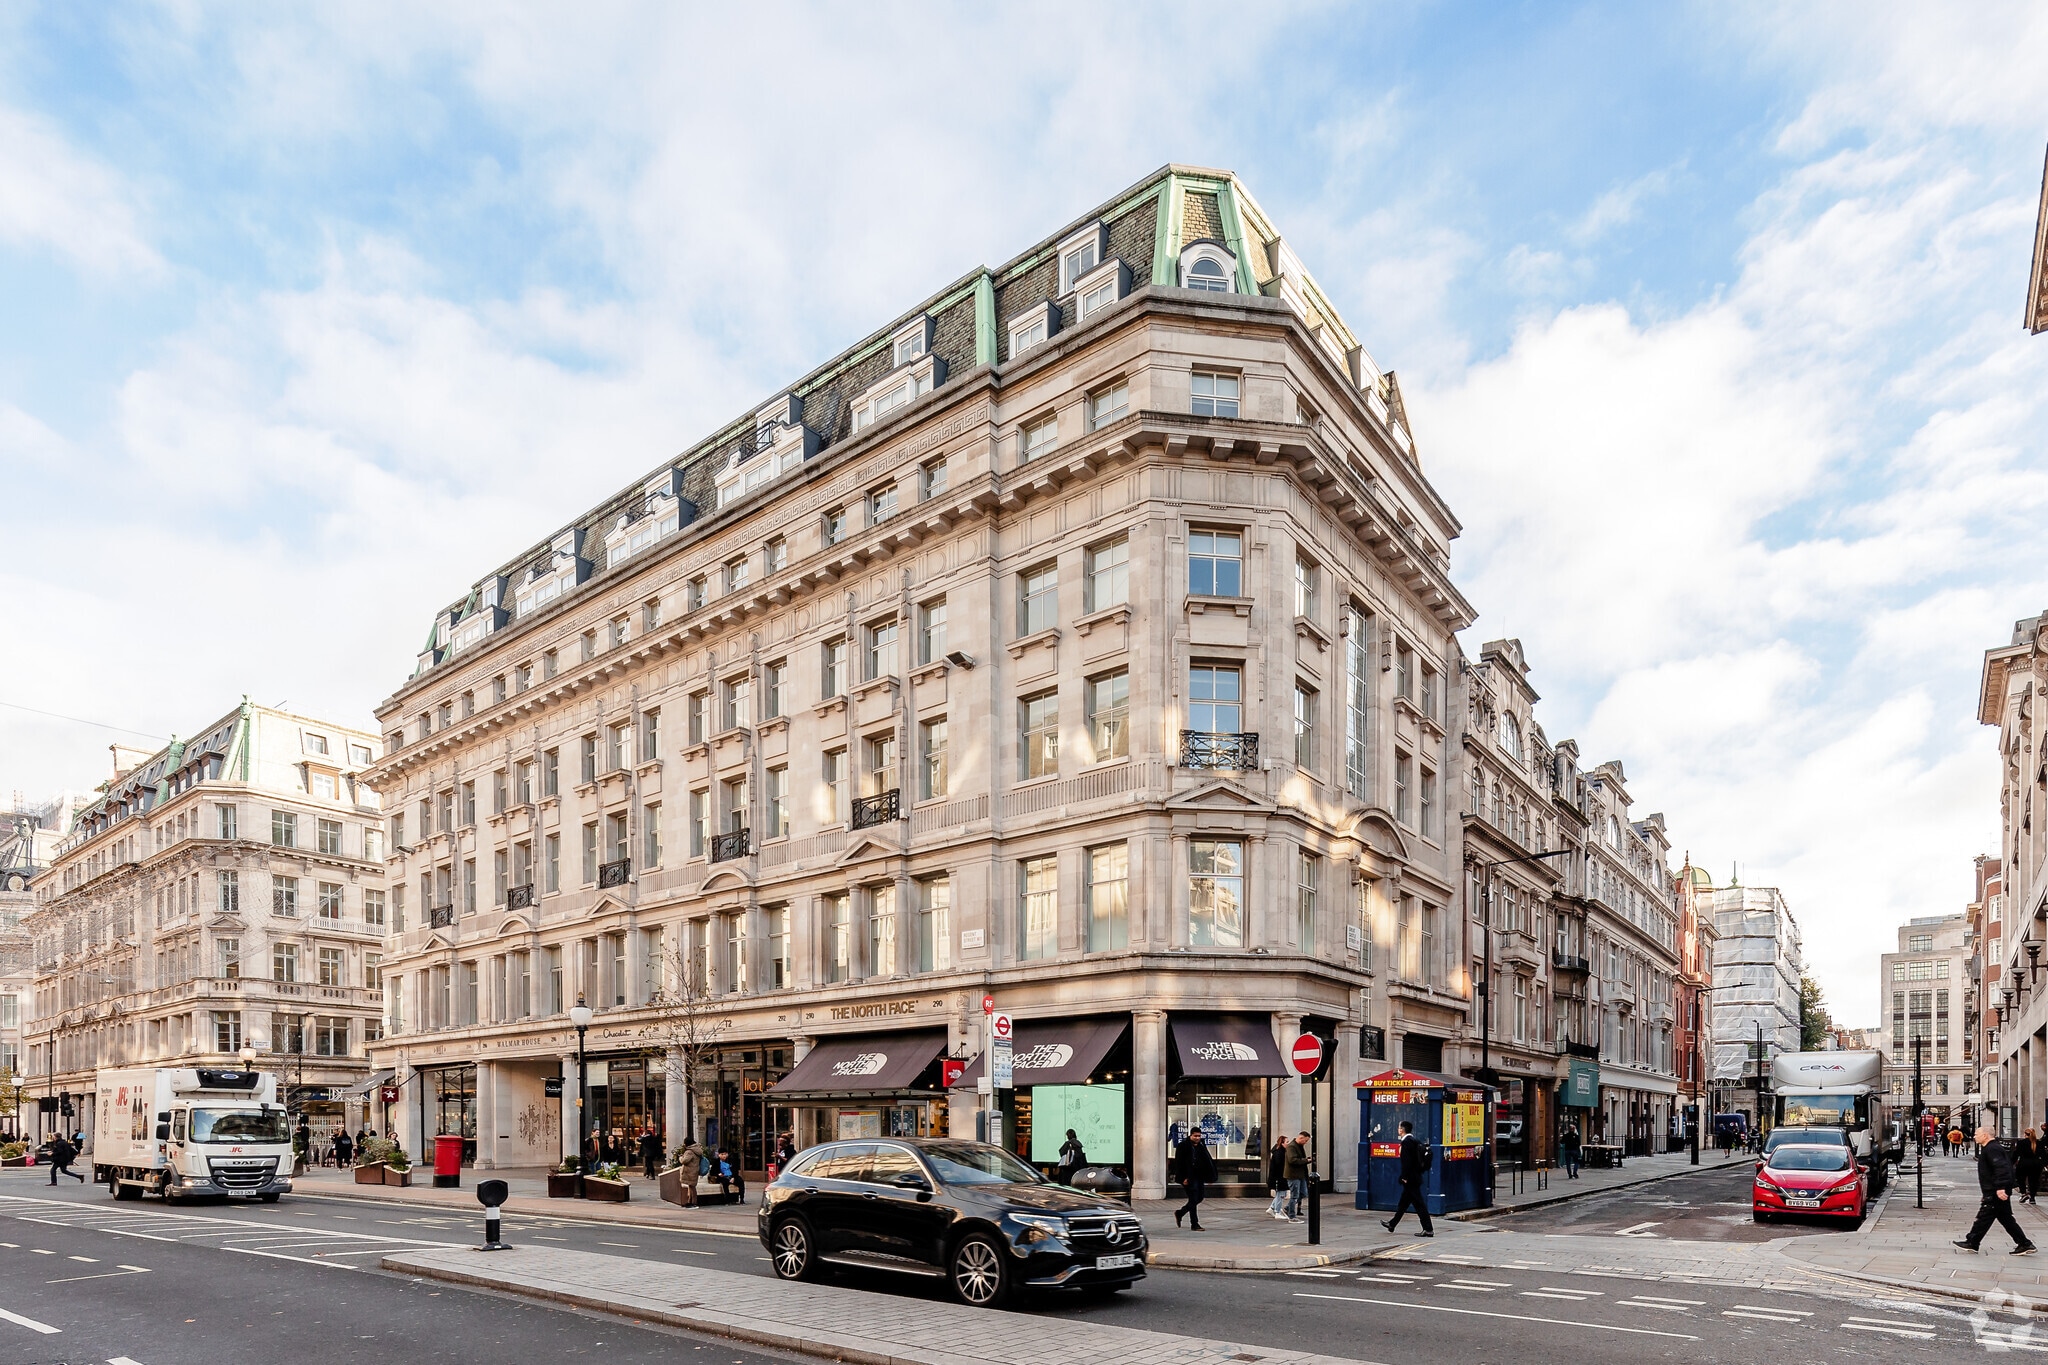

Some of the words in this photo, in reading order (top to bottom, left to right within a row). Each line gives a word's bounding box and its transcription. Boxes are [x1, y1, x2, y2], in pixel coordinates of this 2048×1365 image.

[932, 1000, 943, 1008] 290
[985, 1000, 993, 1008] RF
[830, 1007, 850, 1020] THE
[851, 1003, 887, 1018] NORTH
[888, 1000, 916, 1015] FACE
[805, 1012, 815, 1020] 290
[521, 1037, 541, 1046] HOUSE
[1033, 1043, 1058, 1053] THE
[855, 1053, 877, 1061] THE
[832, 1060, 870, 1069] NORTH
[1012, 1061, 1046, 1069] FACE
[115, 1086, 129, 1106] JFC
[1374, 1094, 1398, 1103] HERE
[1468, 1106, 1480, 1115] VAPE
